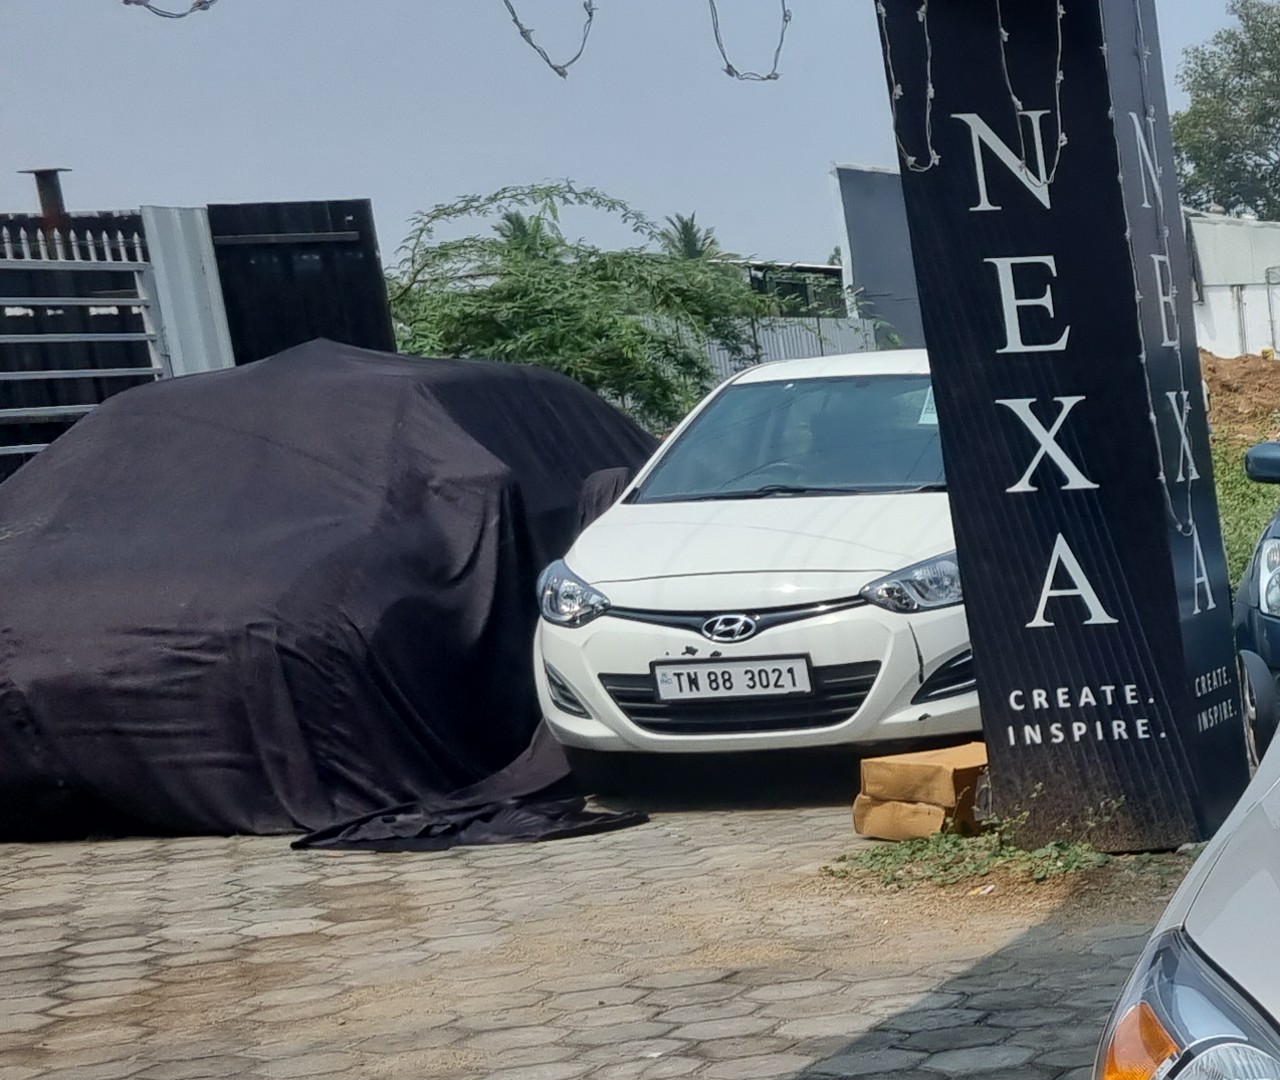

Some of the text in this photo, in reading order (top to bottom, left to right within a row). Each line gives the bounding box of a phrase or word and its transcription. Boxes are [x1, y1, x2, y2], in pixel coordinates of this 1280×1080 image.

[951, 109, 1118, 629] NEXA
[673, 667, 797, 693] TN 88 3021
[1195, 666, 1232, 698] CREATE.
[1009, 684, 1155, 711] CREATE.
[1007, 718, 1167, 746] INSPIRE.
